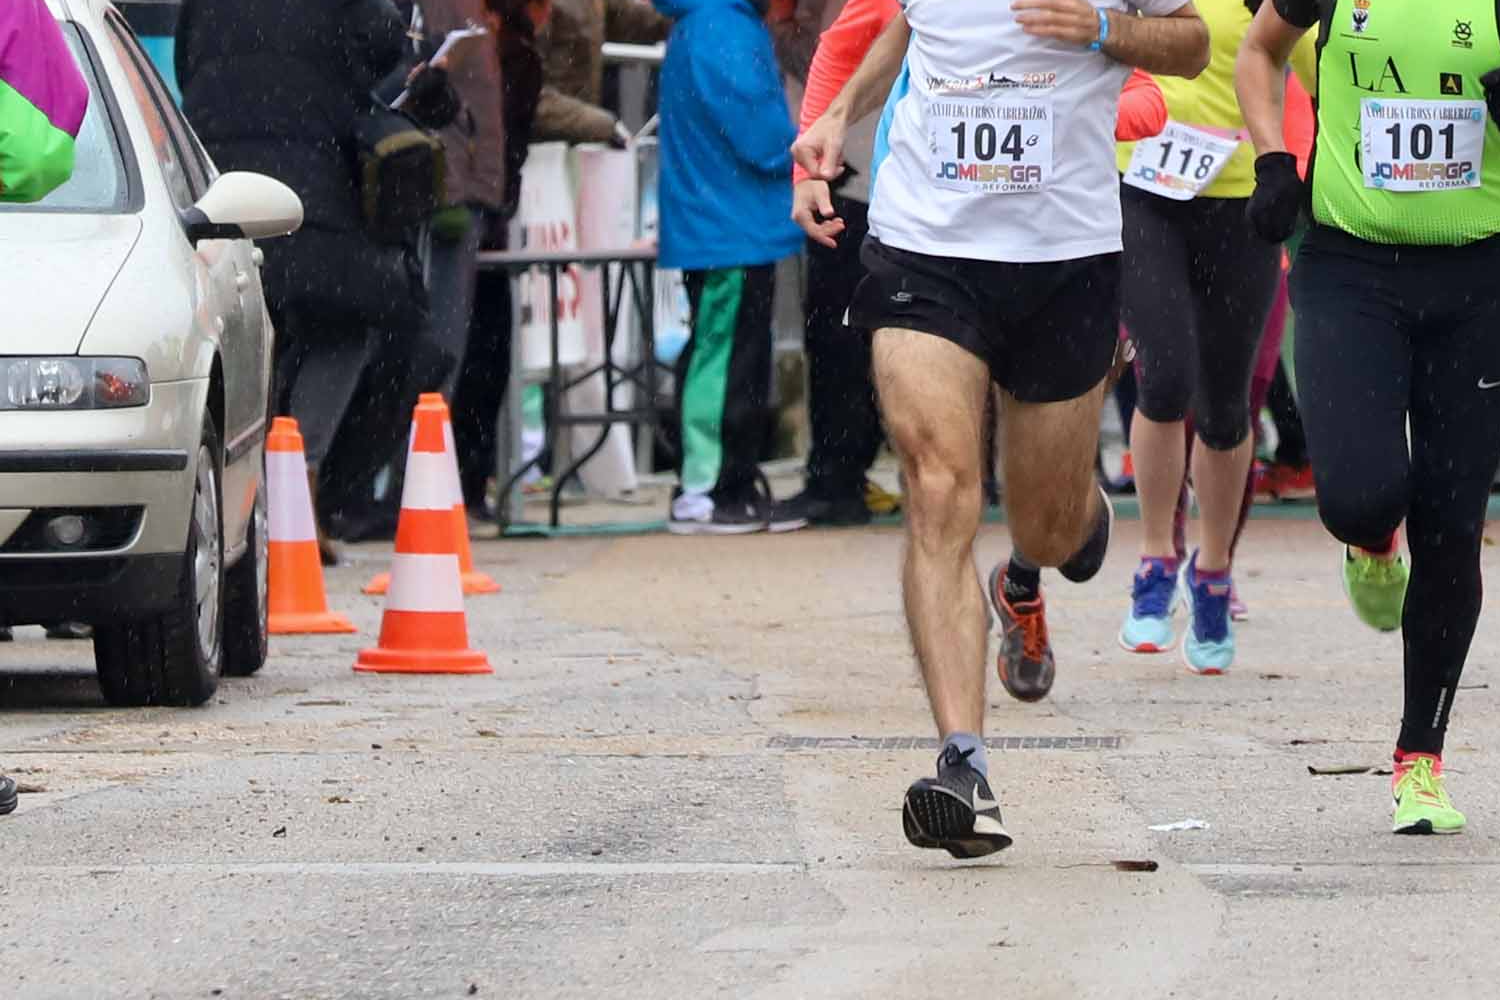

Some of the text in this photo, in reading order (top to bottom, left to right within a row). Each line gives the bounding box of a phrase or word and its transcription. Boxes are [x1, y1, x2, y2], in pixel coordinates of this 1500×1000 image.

[1023, 72, 1057, 84] 2019
[1346, 50, 1411, 94] LA
[950, 121, 1025, 161] 104
[1385, 122, 1455, 160] 101
[936, 161, 1042, 182] JOMISAGA
[1160, 141, 1215, 180] 118
